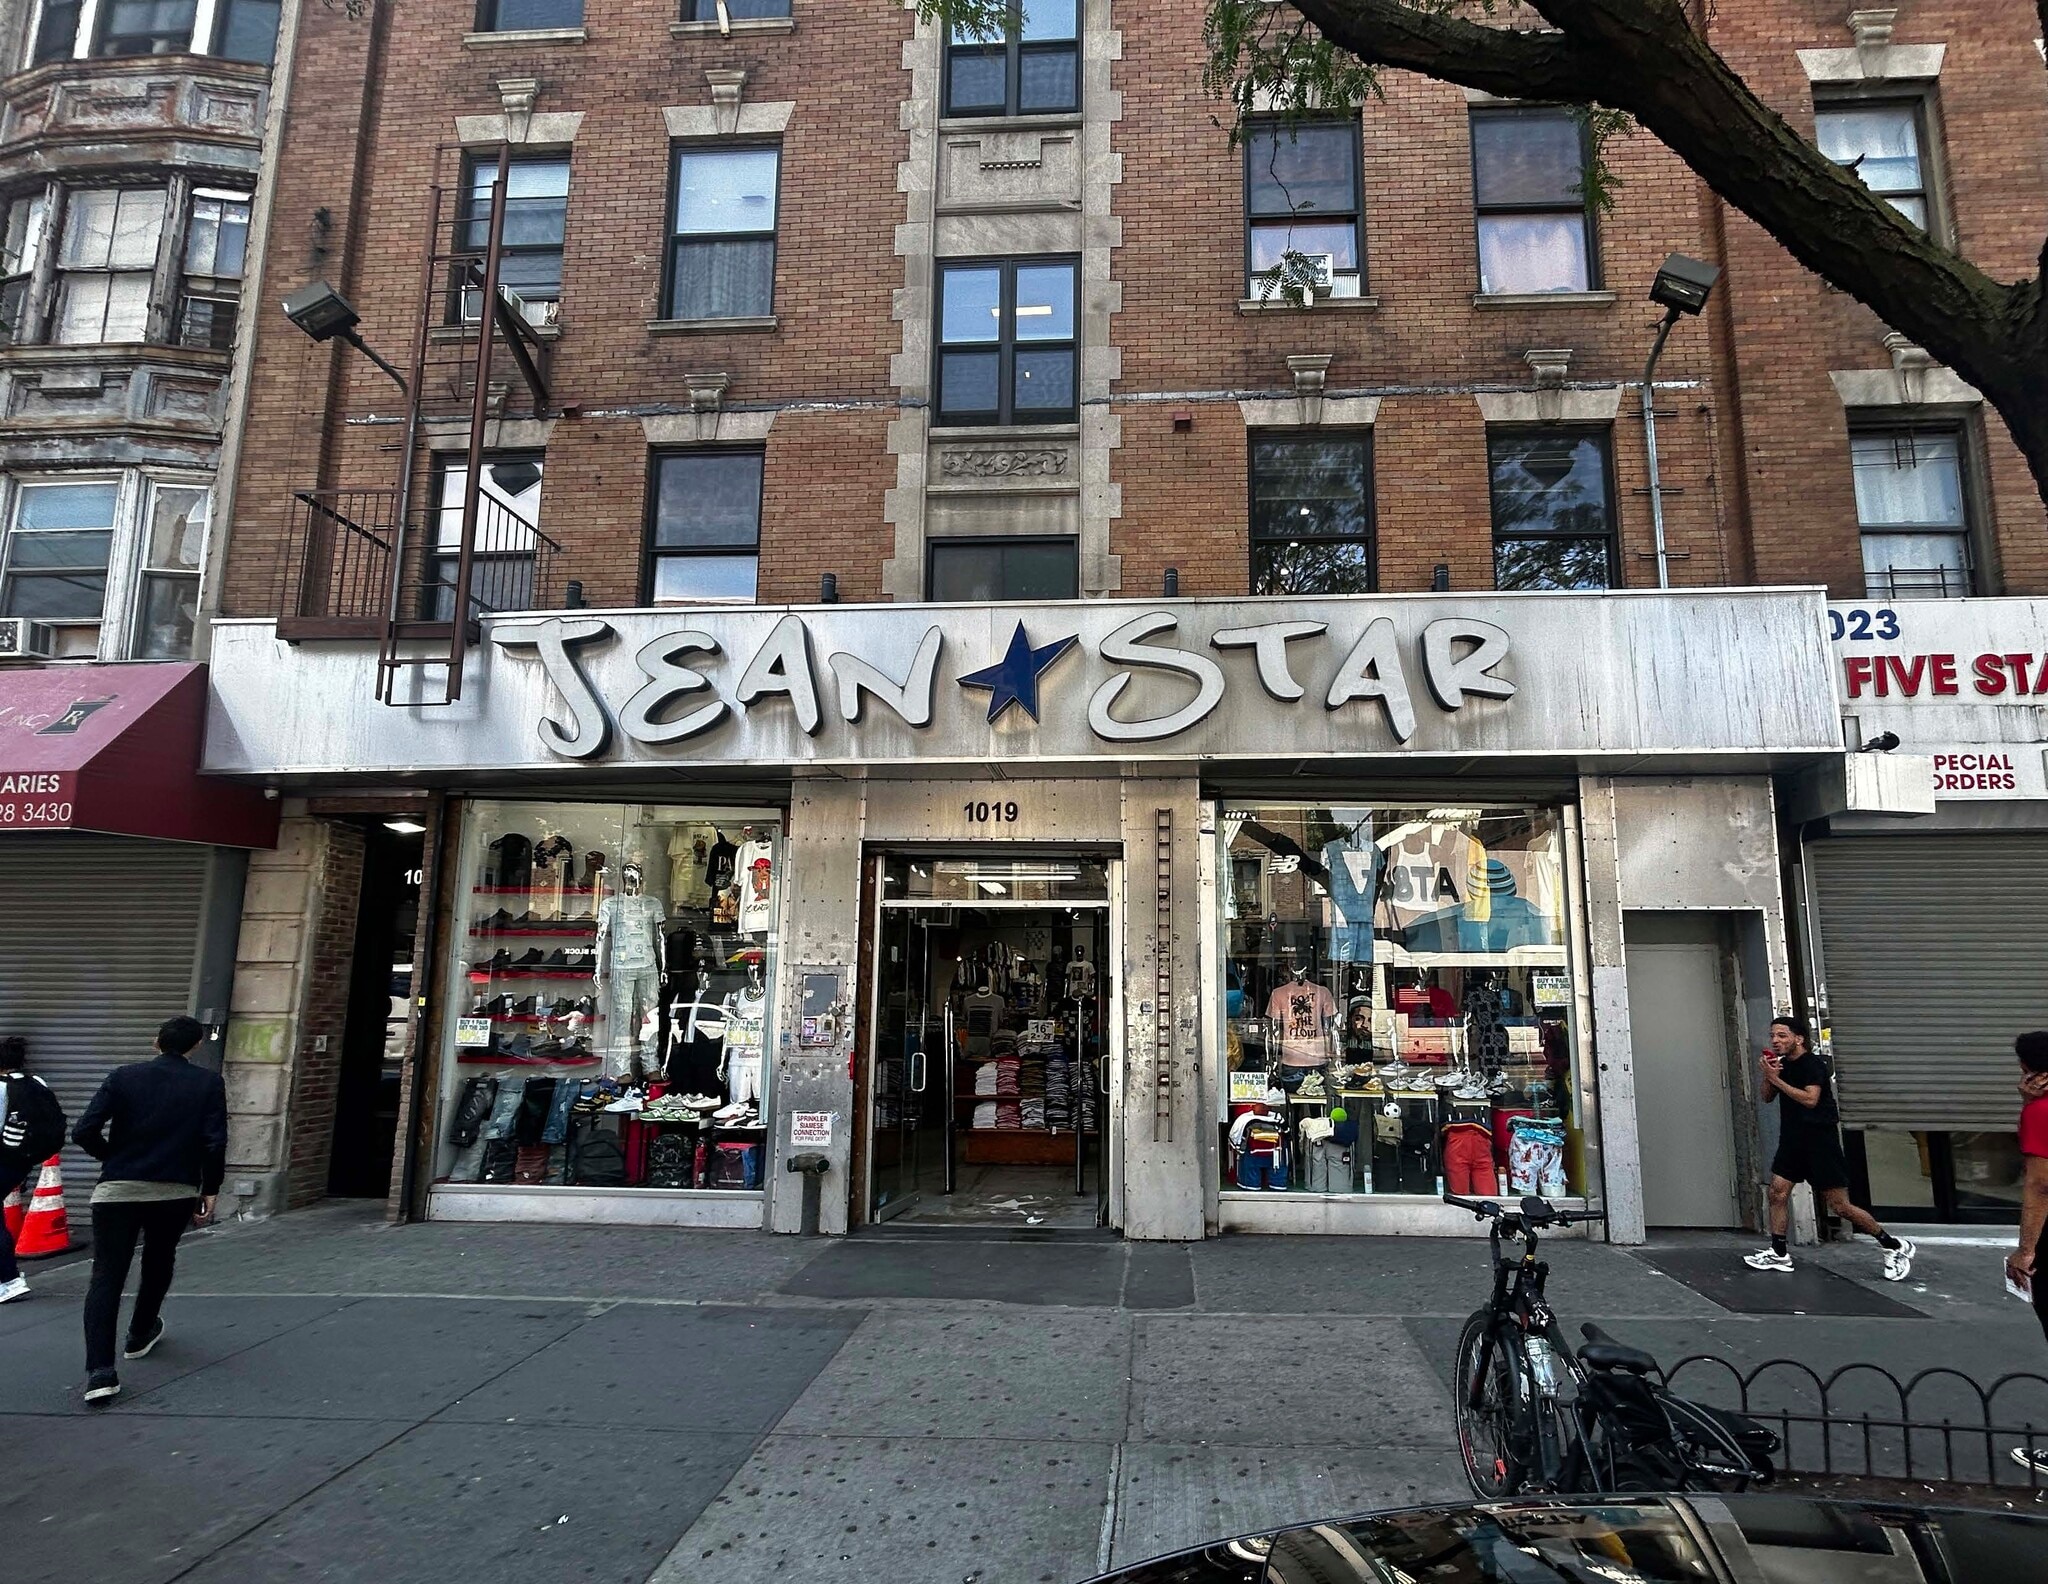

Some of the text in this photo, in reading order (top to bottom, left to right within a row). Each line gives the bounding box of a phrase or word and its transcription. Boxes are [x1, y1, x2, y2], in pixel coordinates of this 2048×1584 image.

[491, 611, 1517, 760] JEAN STAR
[1843, 653, 1959, 699] FIVE
[0, 774, 61, 794] ARIES
[22, 802, 72, 822] 3430
[964, 801, 1019, 823] 1019
[404, 869, 423, 885] 10
